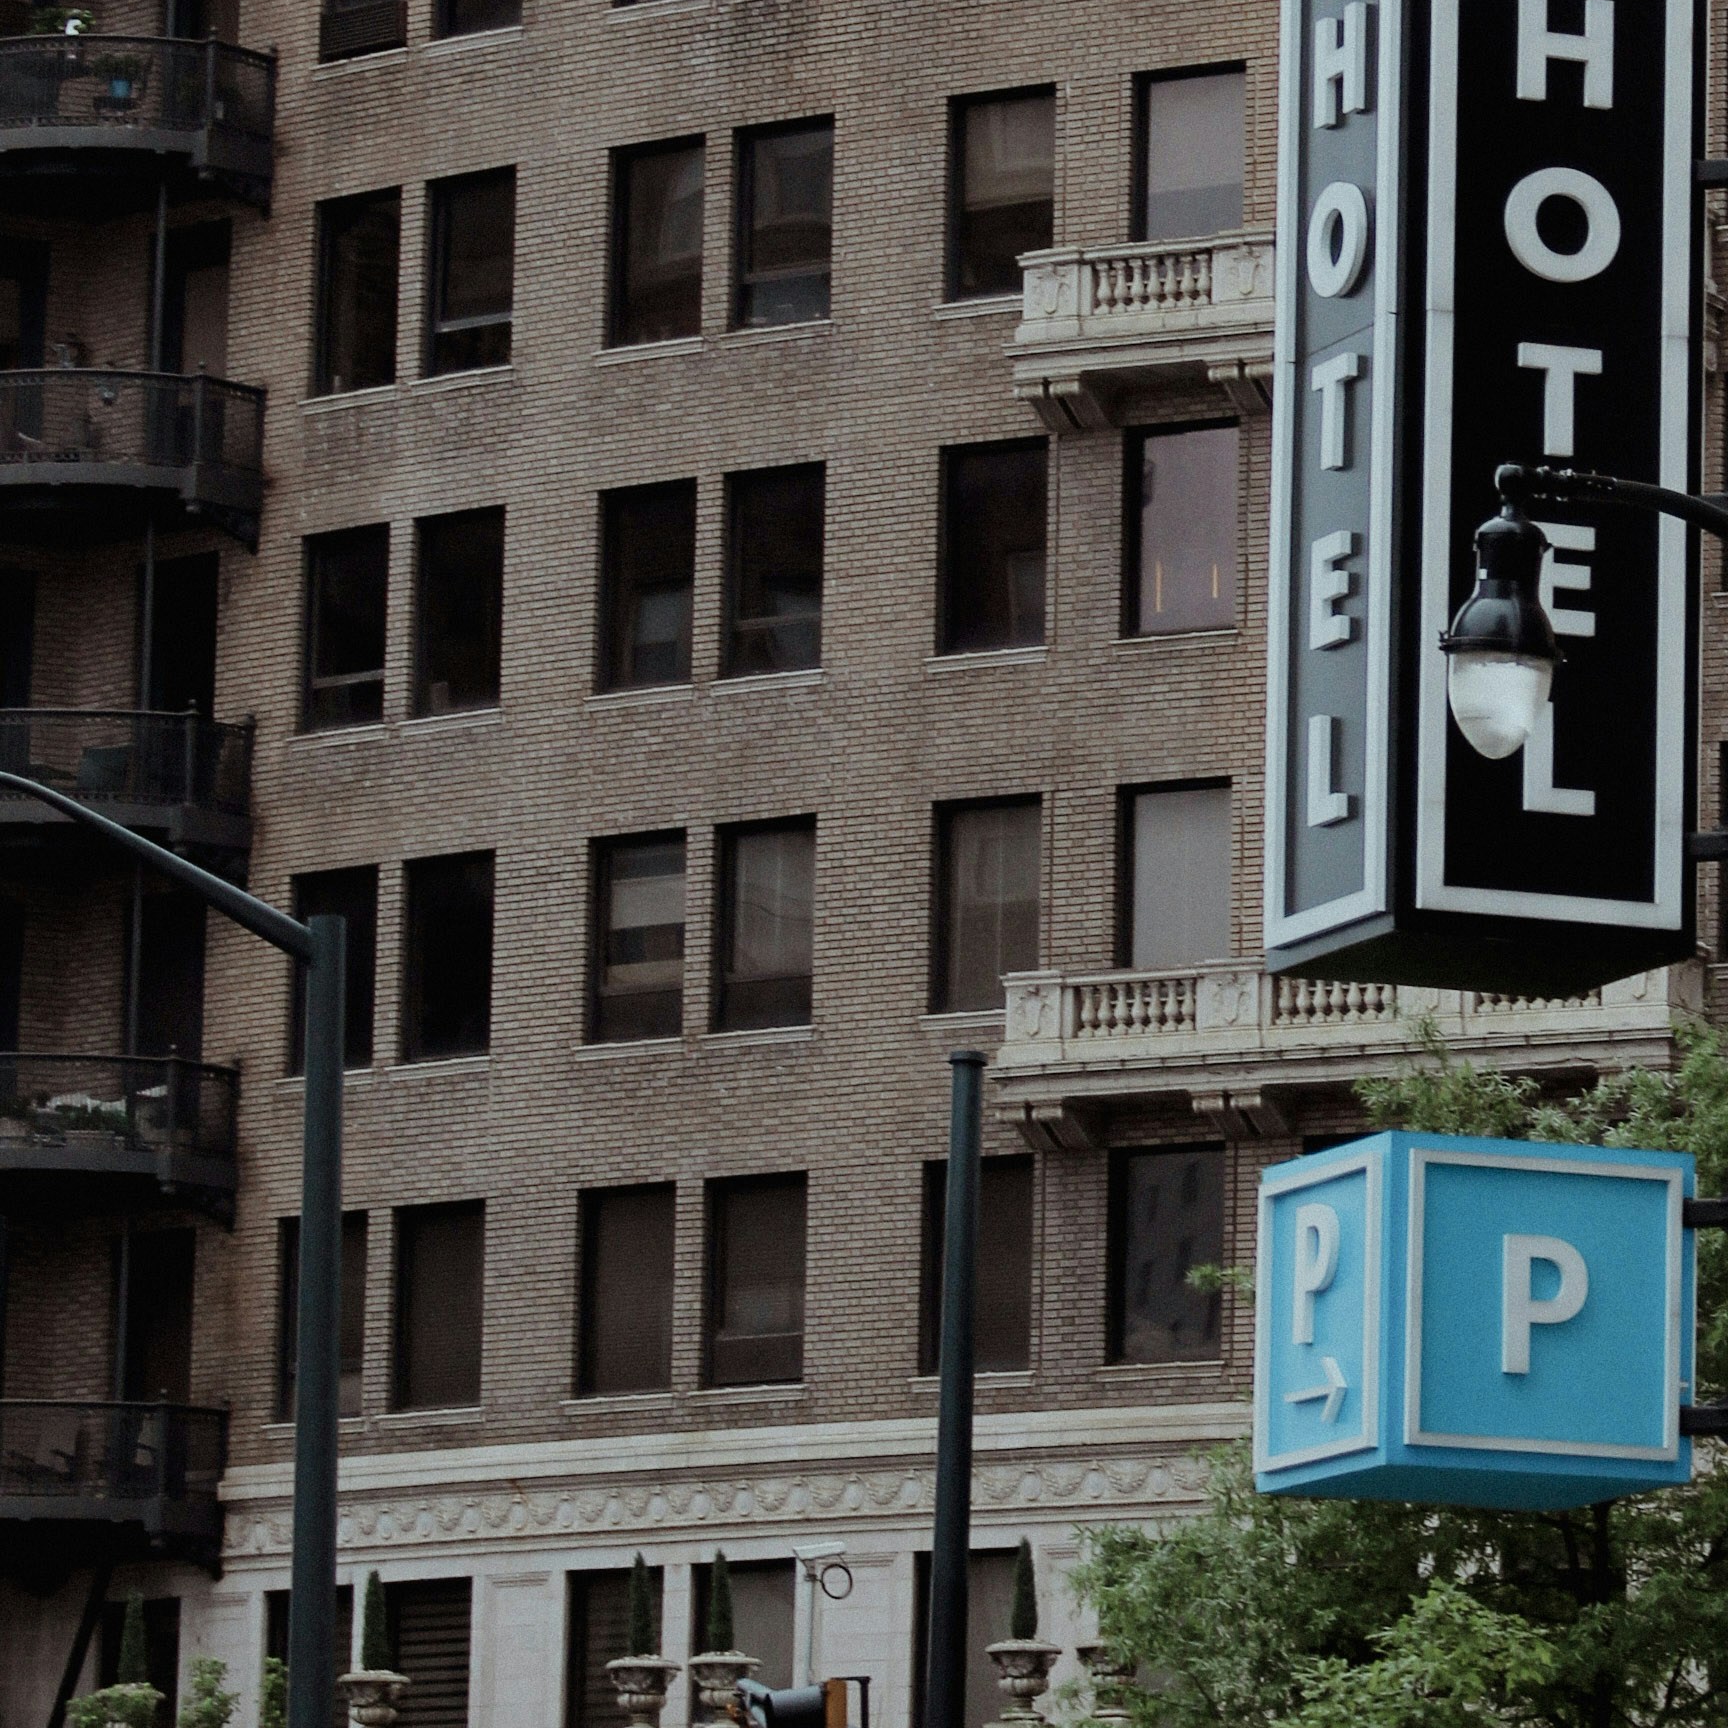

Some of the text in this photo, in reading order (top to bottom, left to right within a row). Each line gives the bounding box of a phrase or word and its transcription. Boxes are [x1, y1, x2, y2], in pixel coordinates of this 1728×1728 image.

[1307, 1, 1368, 828] HOTEL
[1292, 1203, 1341, 1346] P
[1501, 1233, 1589, 1375] P
